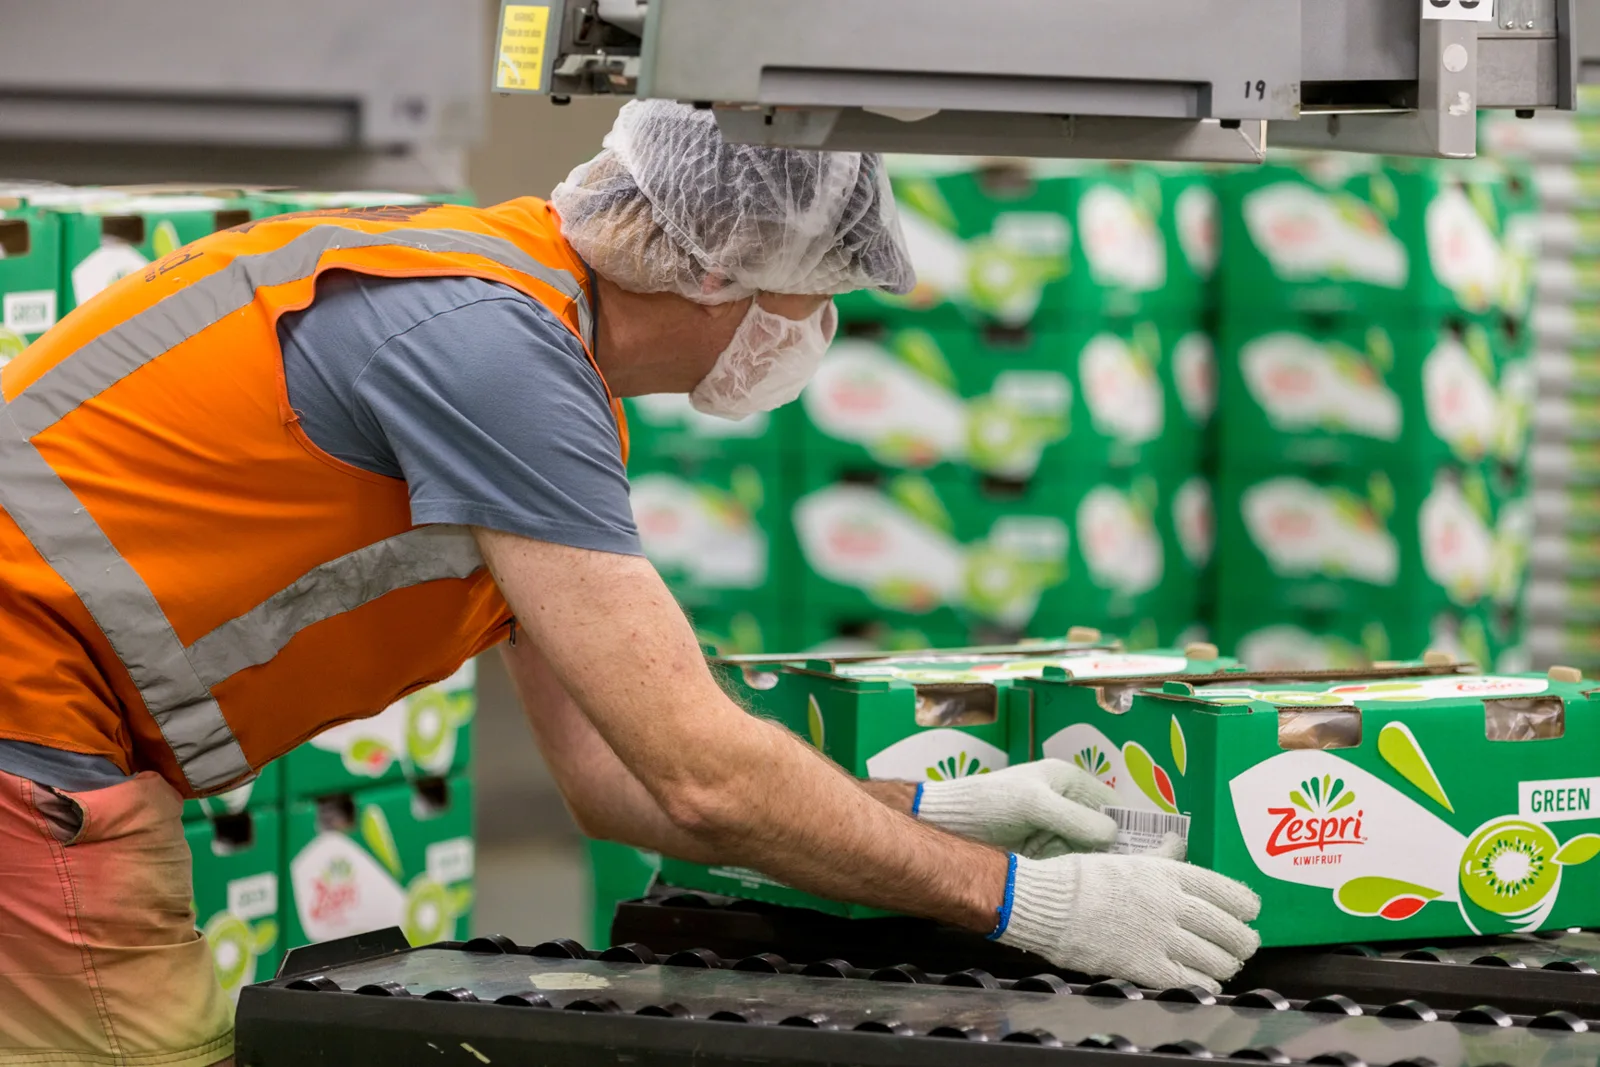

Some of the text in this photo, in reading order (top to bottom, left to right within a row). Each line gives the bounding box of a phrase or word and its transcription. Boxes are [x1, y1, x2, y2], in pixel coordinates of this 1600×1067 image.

[1244, 79, 1266, 101] 19
[1530, 787, 1591, 813] GREEN
[1265, 807, 1365, 857] Zespri
[1293, 854, 1343, 866] KIWIFRUIT
